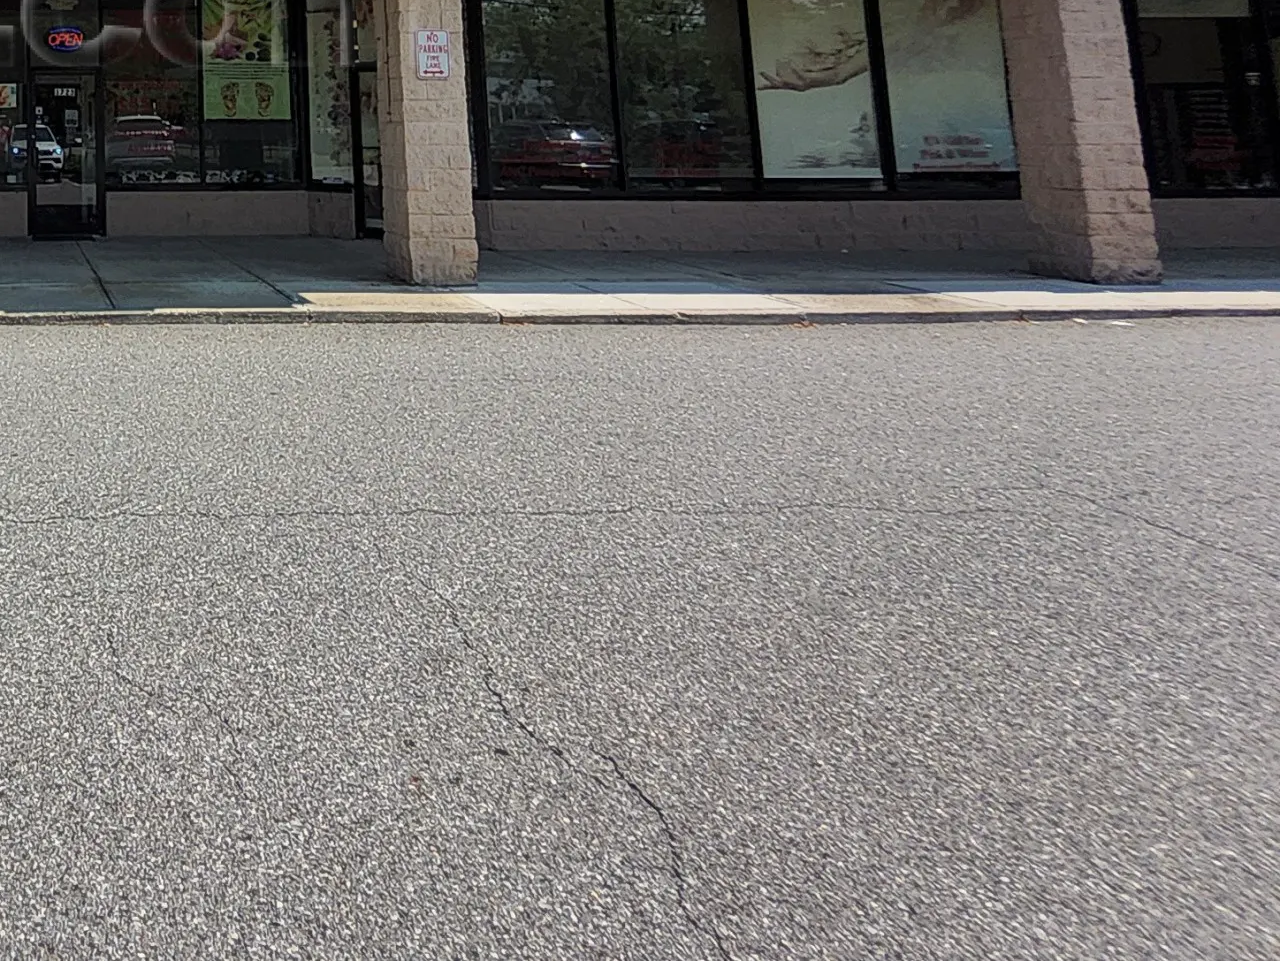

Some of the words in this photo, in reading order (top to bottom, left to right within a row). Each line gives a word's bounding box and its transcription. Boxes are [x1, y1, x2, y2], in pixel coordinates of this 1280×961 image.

[48, 32, 83, 46] OPEN
[426, 33, 439, 43] NO
[419, 44, 449, 53] PARKING
